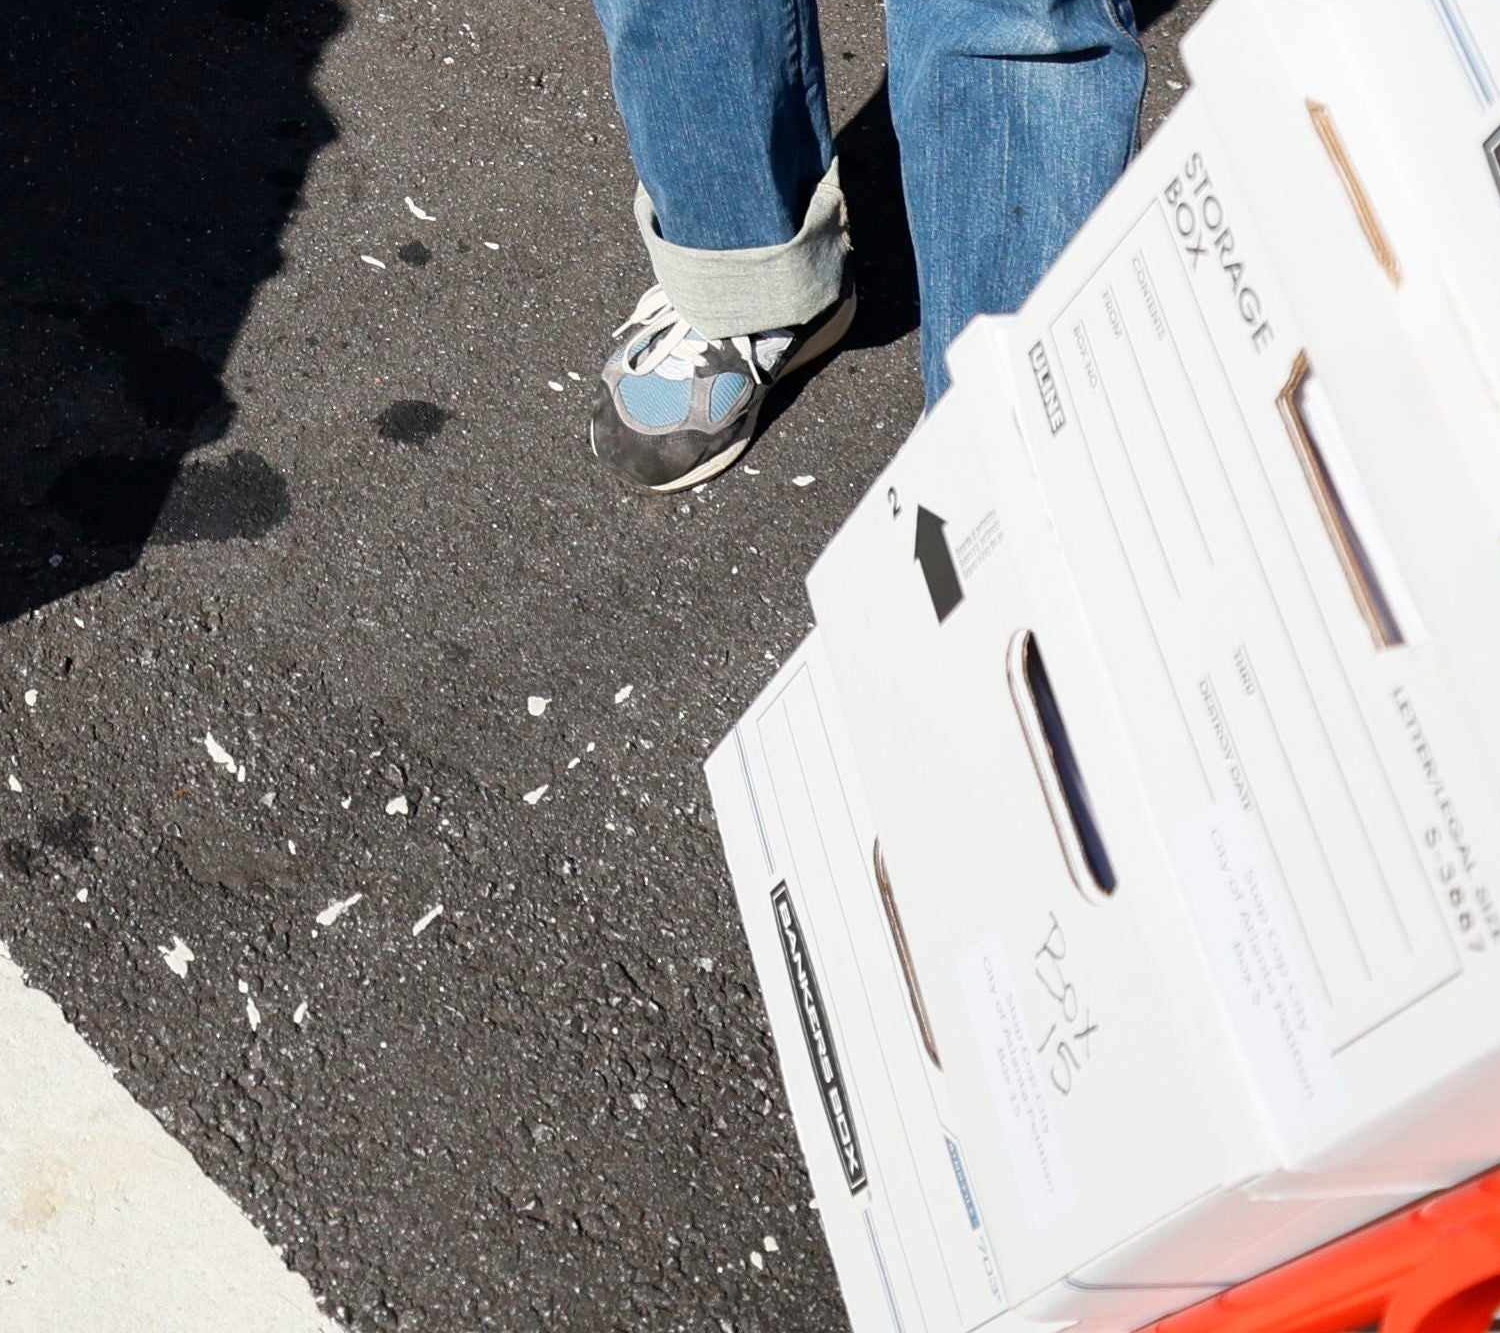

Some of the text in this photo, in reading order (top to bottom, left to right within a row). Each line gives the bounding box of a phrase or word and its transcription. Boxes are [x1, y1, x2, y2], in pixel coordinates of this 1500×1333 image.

[1163, 175, 1209, 273] BOX
[1184, 151, 1276, 356] STORAGE
[1072, 323, 1090, 357] BOX
[1101, 289, 1124, 341] FROM
[1131, 255, 1168, 343] CONTENTS
[1029, 341, 1066, 436] ULINE
[887, 486, 902, 520] 2
[1231, 647, 1257, 698] THRU
[1199, 678, 1255, 813] DESTROY DATE
[1210, 827, 1317, 1102] City of Atlanta Petition
[1232, 940, 1254, 986] Box
[1244, 866, 1310, 1033] Stop Cop City
[778, 900, 860, 1176] BANKERS BOX
[982, 954, 998, 996] City
[995, 1000, 1007, 1022] of
[1003, 1026, 1029, 1103] Atlanta
[998, 1046, 1012, 1086] Box
[1006, 992, 1051, 1136] Stop Cop City
